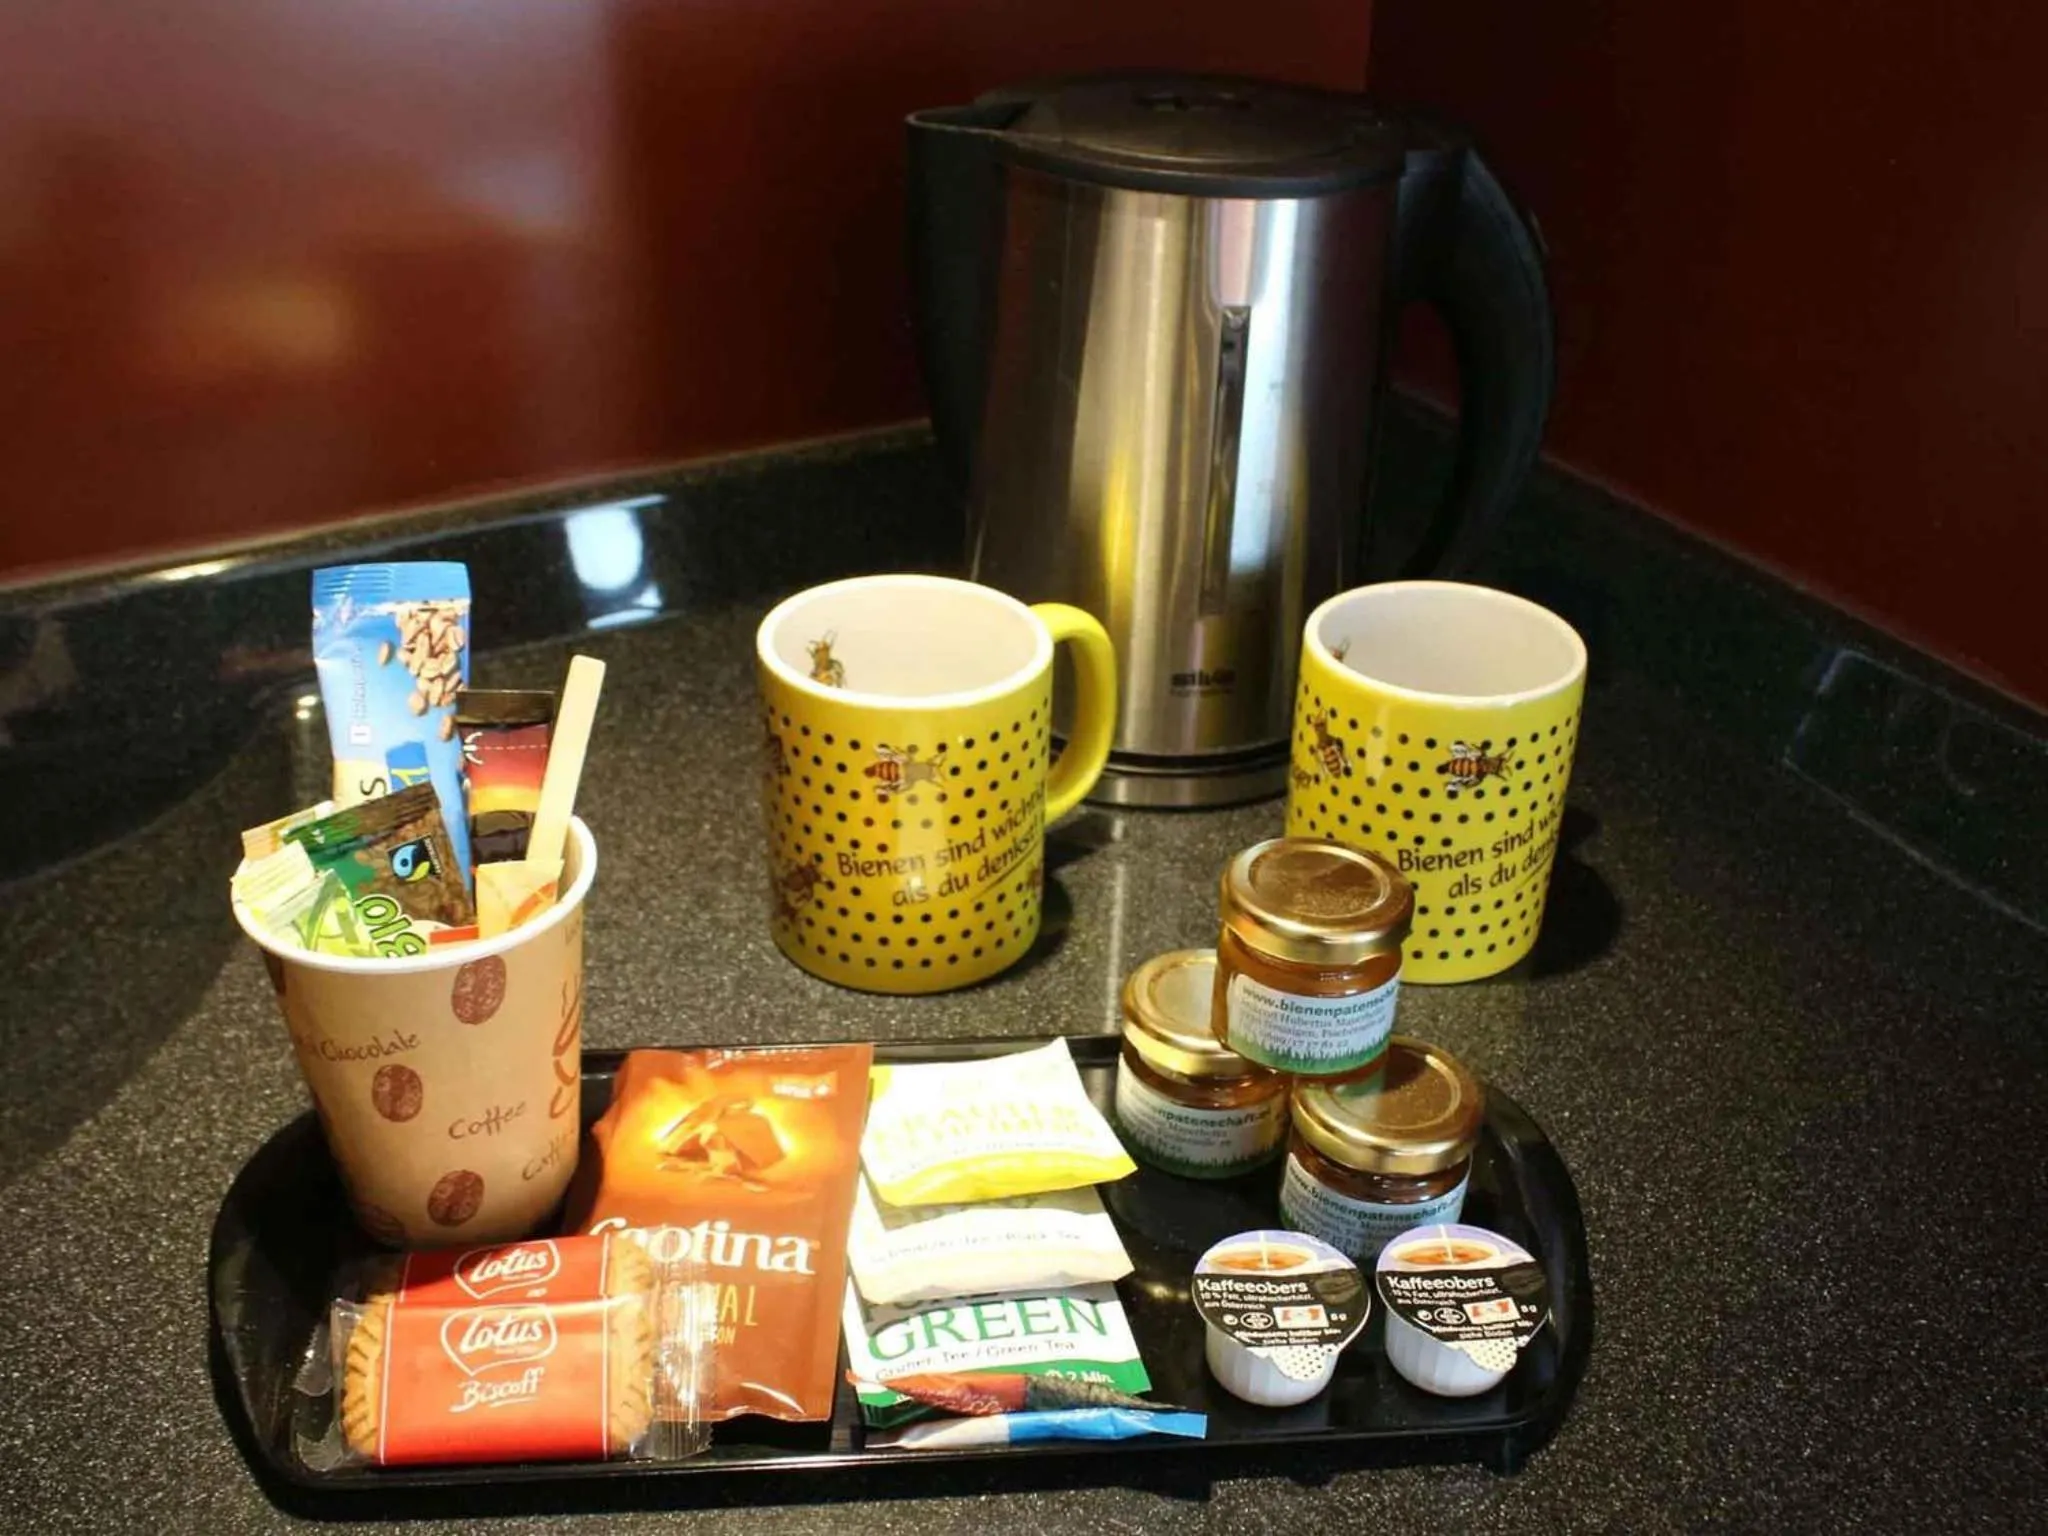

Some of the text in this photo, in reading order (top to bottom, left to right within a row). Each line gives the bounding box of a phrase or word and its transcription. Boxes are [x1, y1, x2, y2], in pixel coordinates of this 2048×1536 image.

[837, 850, 926, 880] Bienen
[936, 826, 986, 868] sind
[1397, 847, 1484, 873] Bienen
[1491, 816, 1534, 859] sind
[892, 879, 930, 907] als
[938, 867, 970, 899] du
[1448, 870, 1482, 899] als
[1489, 861, 1516, 888] du
[320, 1029, 422, 1062] Chocolate
[448, 1101, 528, 1140] Coffee
[469, 1248, 548, 1284] Lotus
[1387, 1275, 1496, 1291] Kaffeeobers
[1197, 1278, 1309, 1295] Kaffeeobers
[459, 1312, 543, 1355] Lotus
[868, 1296, 1108, 1361] GREEN
[448, 1366, 545, 1413] Biscoff
